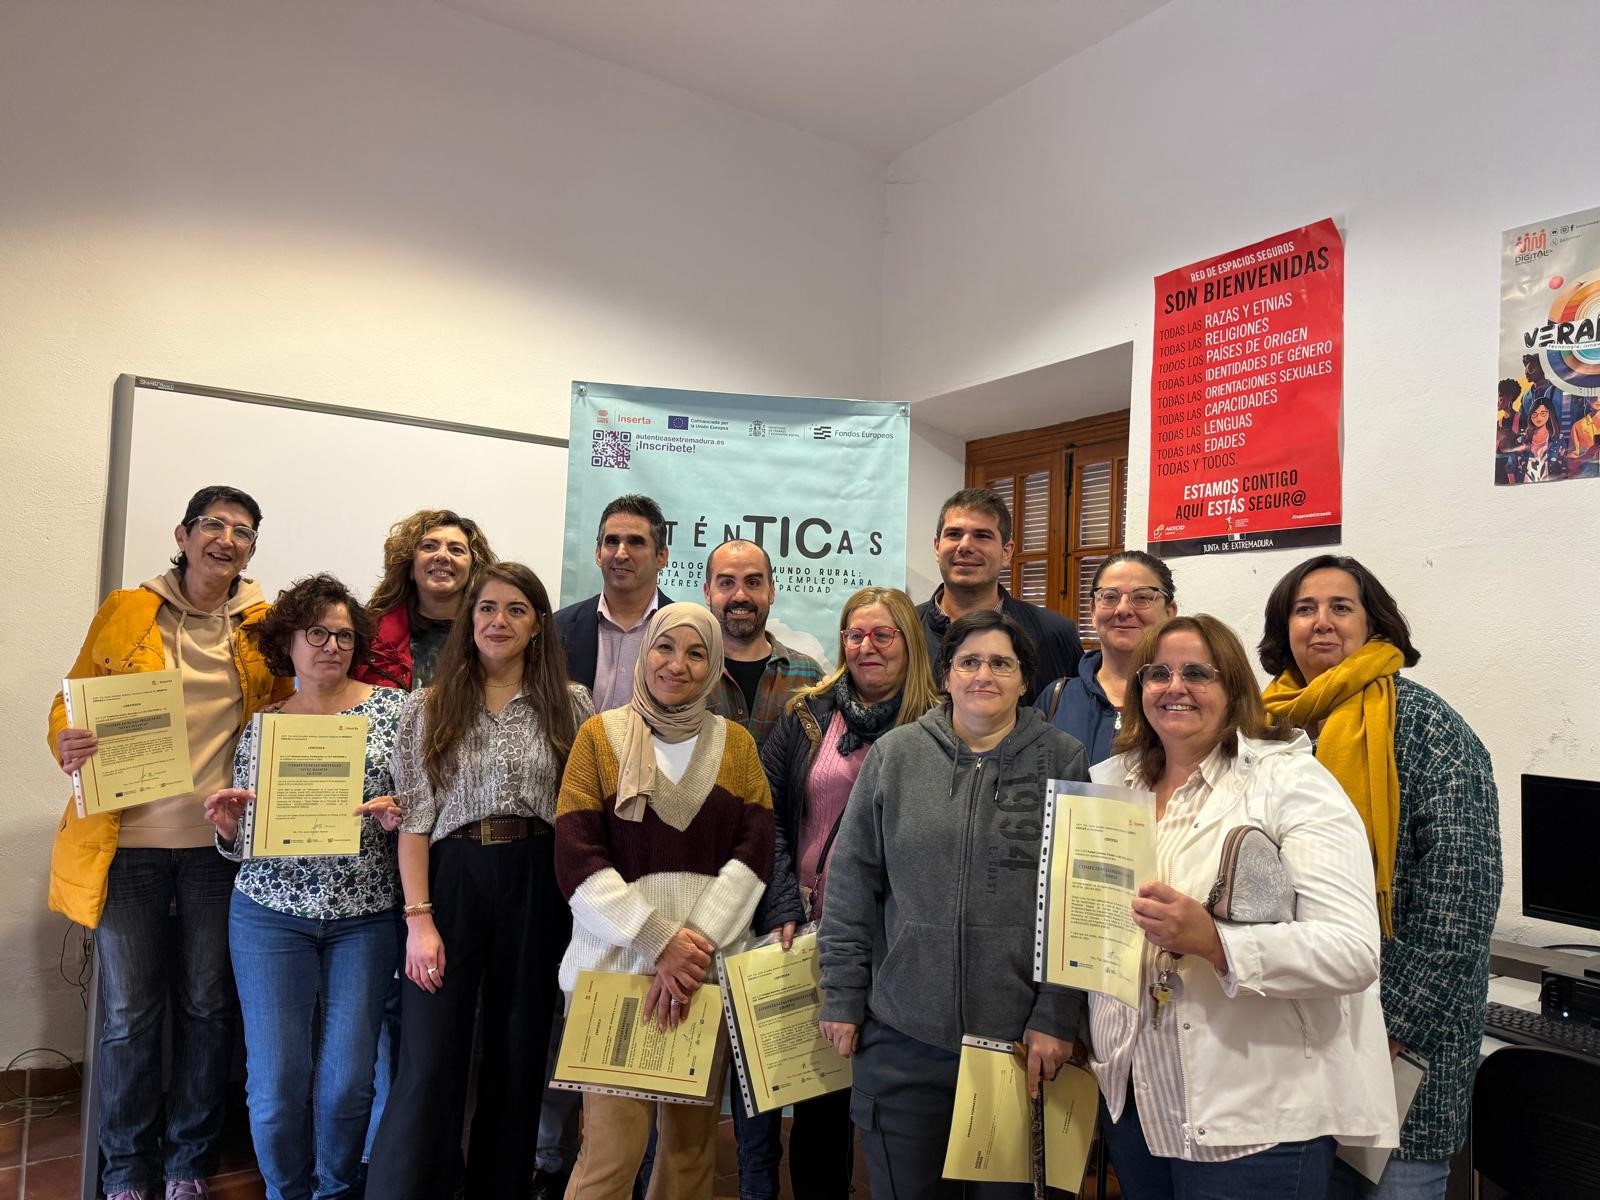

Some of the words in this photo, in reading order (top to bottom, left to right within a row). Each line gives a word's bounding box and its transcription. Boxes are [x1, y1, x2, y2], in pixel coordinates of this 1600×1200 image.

[1190, 272, 1205, 282] RED
[1206, 268, 1217, 278] DE
[1218, 252, 1256, 274] ESPACIOS
[1256, 242, 1294, 262] SEGUROS
[1164, 287, 1197, 314] SON
[1204, 246, 1329, 304] BIENVENIDAS
[1160, 325, 1185, 341] TODAS
[1188, 320, 1202, 333] LAS
[1205, 307, 1239, 328] RAZAS
[1243, 304, 1250, 318] Y
[1253, 292, 1292, 315] ETNIAS
[1159, 360, 1185, 374] TODOS
[1188, 354, 1204, 367] LOS
[1206, 342, 1242, 364] PAÍSES
[1246, 338, 1260, 354] DE
[1264, 326, 1308, 350] ORIGEN
[1160, 343, 1185, 358] TODAS
[1188, 338, 1202, 350] LAS
[1205, 318, 1269, 346] RELIGIONES
[1158, 376, 1184, 391] TODAS
[1188, 372, 1202, 386] LAS
[1206, 355, 1267, 382] IDENTIDADES
[1270, 351, 1284, 366] DE
[1288, 340, 1332, 362] GÉNERO
[1158, 395, 1184, 409] TODAS
[1188, 390, 1202, 404] LAS
[1206, 372, 1276, 399] ORIENTACIONES
[1280, 360, 1332, 383] SEXUALES
[1158, 412, 1184, 426] TODAS
[1187, 408, 1202, 421] LAS
[1204, 388, 1278, 418] CAPACIDADES
[636, 433, 724, 446] autenticasextremadura.es
[834, 430, 860, 438] Fondos
[861, 431, 894, 440] Europeos
[1158, 429, 1184, 444] TODAS
[1186, 426, 1201, 439] LAS
[1204, 412, 1252, 435] LENGUAS
[1158, 446, 1184, 460] TODAS
[1186, 443, 1201, 456] LAS
[1204, 432, 1246, 452] EDADES
[1158, 460, 1189, 477] TODAS
[1193, 458, 1199, 469] Y
[1202, 452, 1238, 470] TODOS.
[1184, 478, 1238, 500] ESTAMOS
[1242, 469, 1298, 492] CONTIGO
[1176, 500, 1204, 520] AQUÍ
[1208, 496, 1245, 516] ESTÁS
[1248, 490, 1306, 512] SEGUR@
[664, 514, 882, 559] TÉNTICAS
[1203, 544, 1220, 554] JUNTA
[1222, 542, 1229, 550] DE
[1232, 538, 1274, 550] EXTREMADURA
[656, 578, 698, 588] UJERES
[779, 584, 830, 594] PACIDAD
[788, 576, 834, 584] EMPLEO
[844, 578, 872, 586] PARA
[820, 568, 862, 578] RURAL:
[997, 773, 1042, 871] 1994
